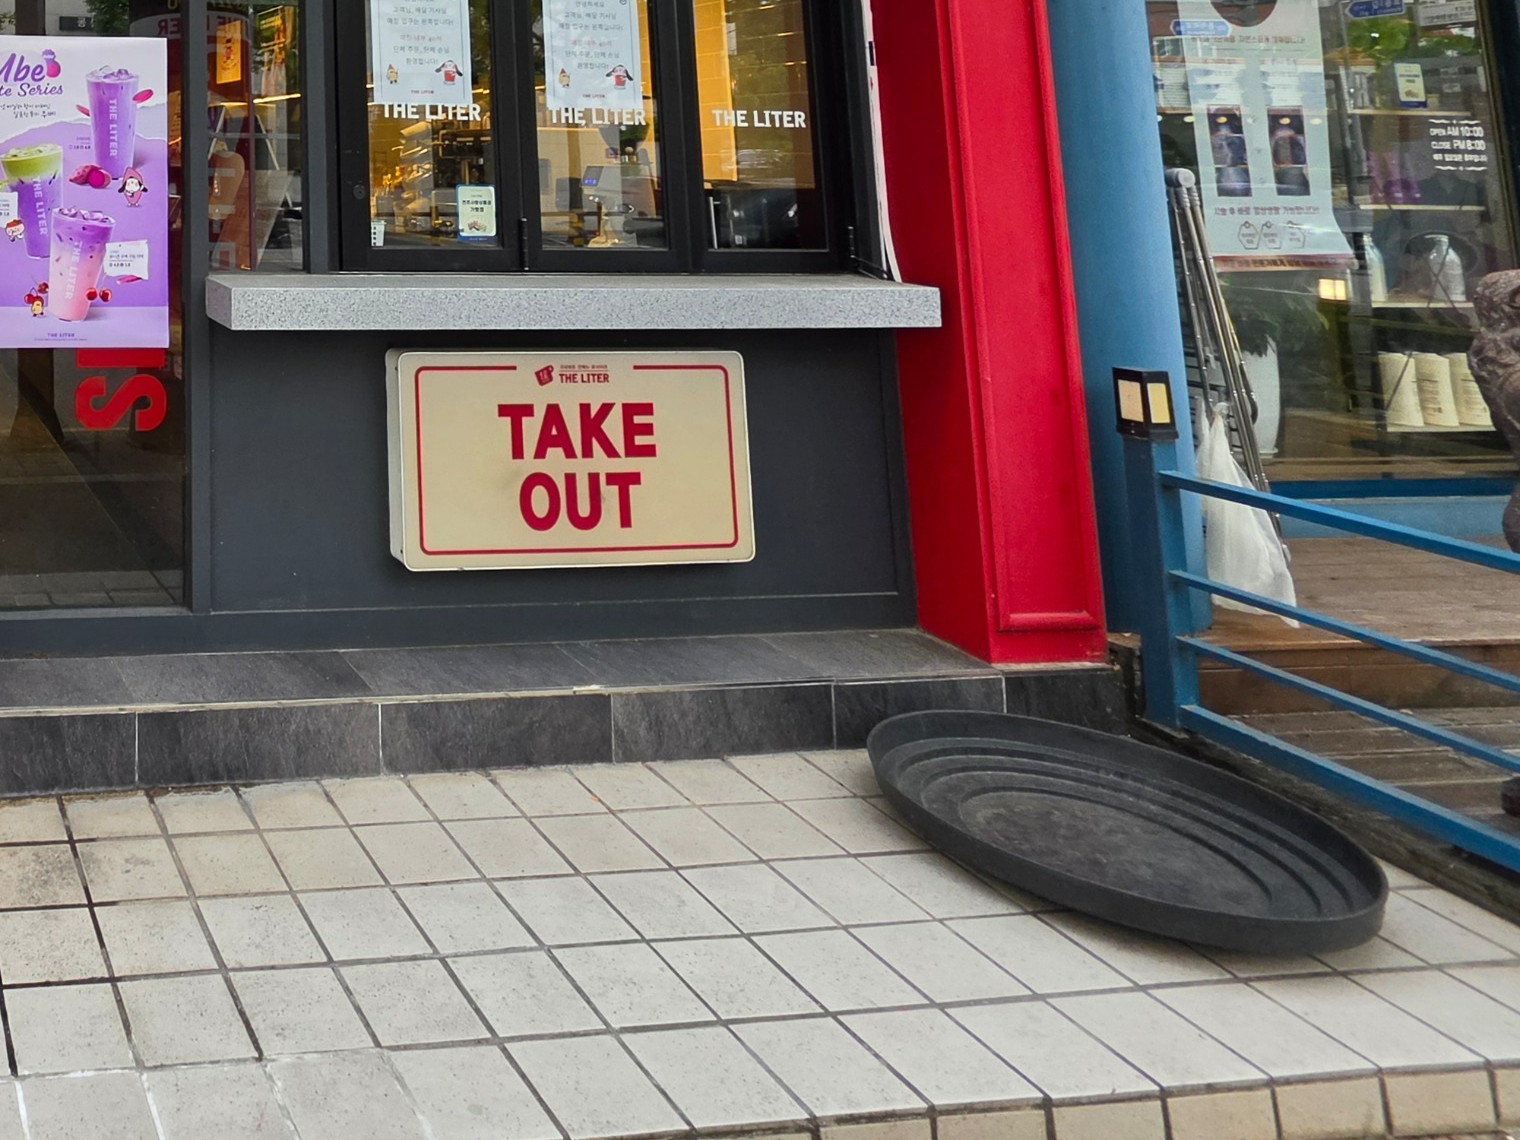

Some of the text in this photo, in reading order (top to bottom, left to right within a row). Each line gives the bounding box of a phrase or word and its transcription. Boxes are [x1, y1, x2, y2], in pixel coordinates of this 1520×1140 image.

[17, 82, 63, 97] Series
[384, 104, 481, 121] THE LITER
[550, 108, 646, 126] THE LITER
[712, 109, 806, 128] THE LITER
[109, 99, 118, 157] THE LITER
[1429, 126, 1484, 137] OPEN AM 10:00
[1431, 139, 1486, 150] CLOSE PM 8:00
[32, 176, 49, 235] THE LITER
[64, 266, 78, 300] LITER
[559, 373, 609, 383] THE LITER
[497, 402, 657, 460] TAKE
[519, 471, 642, 531] OUT
